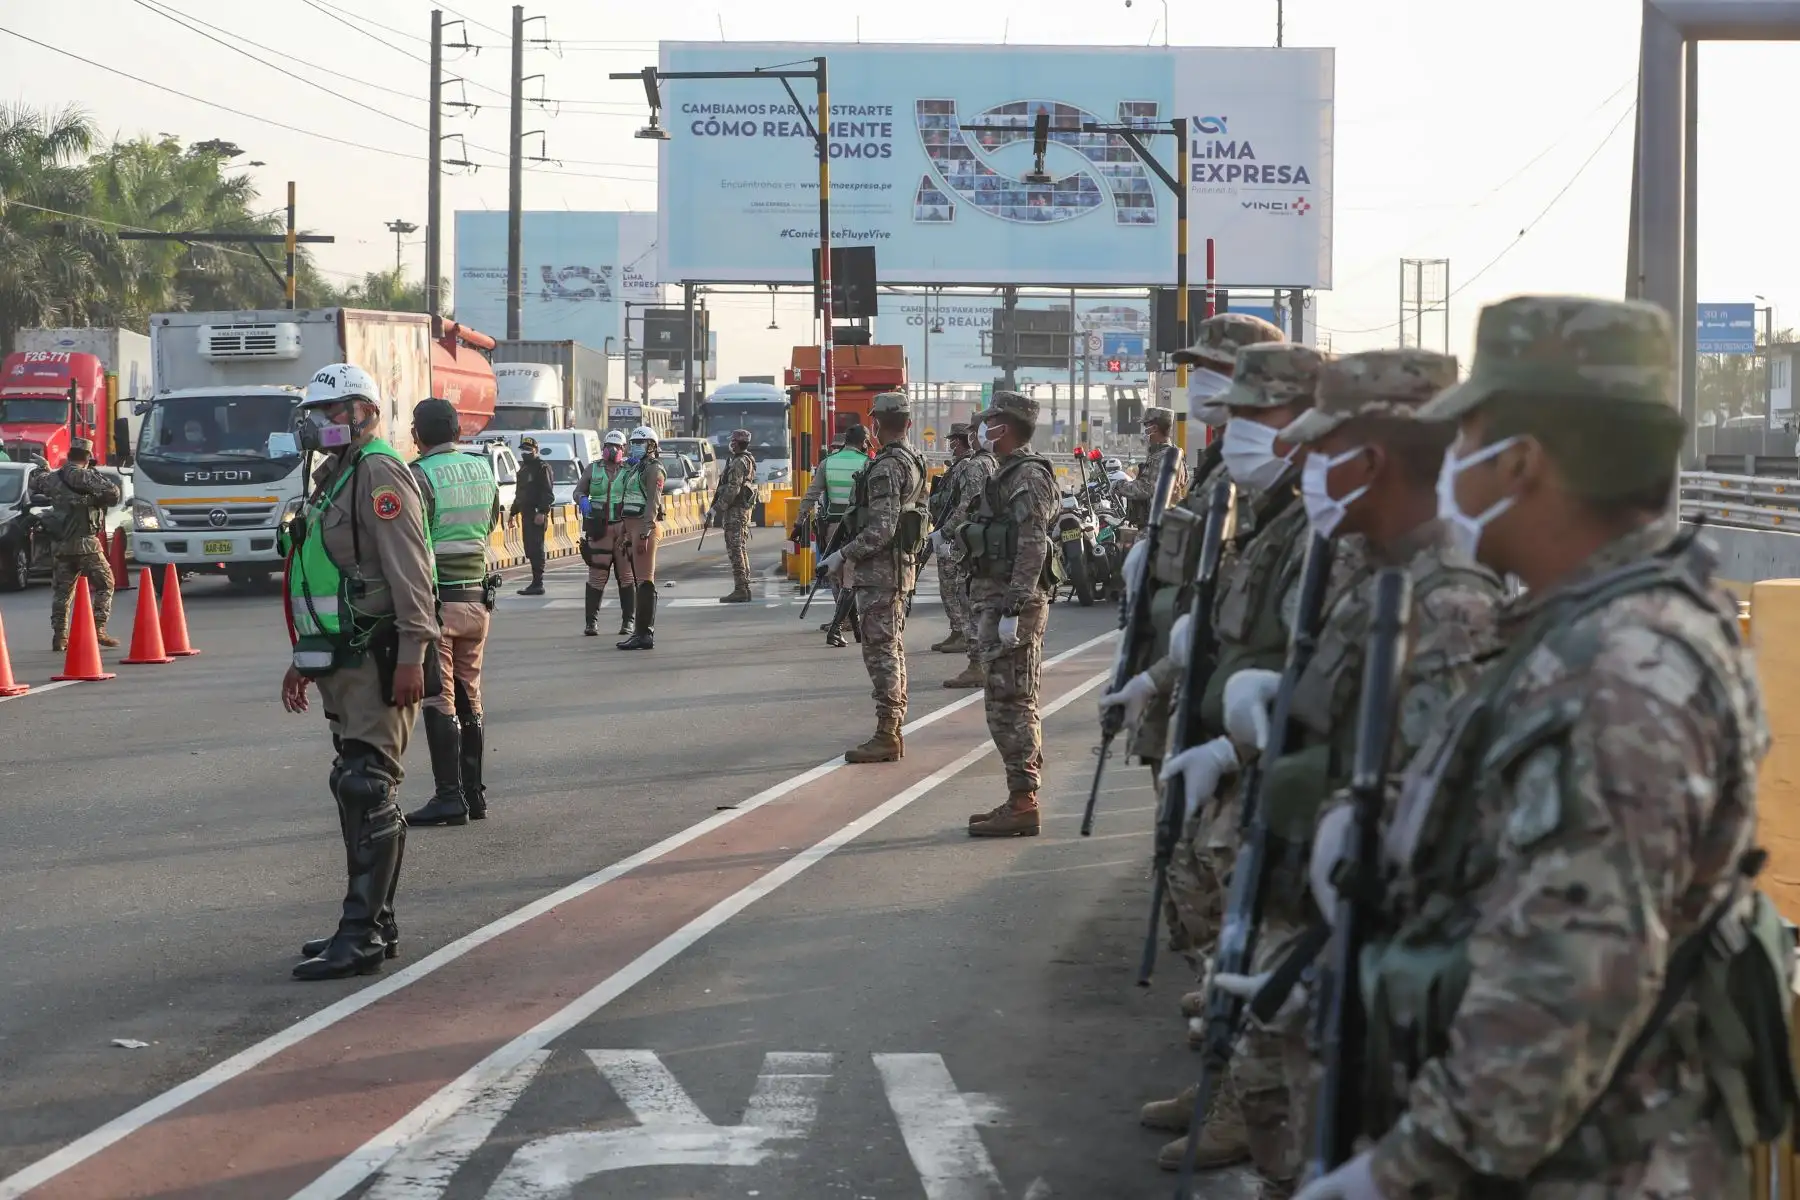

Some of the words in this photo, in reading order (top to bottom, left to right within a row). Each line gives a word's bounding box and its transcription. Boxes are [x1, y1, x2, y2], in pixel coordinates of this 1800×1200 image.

[681, 103, 766, 115] CAMBIAMOS
[808, 105, 893, 116] MSTRARTE
[691, 115, 757, 137] CÓMO
[1191, 163, 1311, 185] EXPRESA
[1241, 201, 1288, 210] VINCI
[24, 351, 71, 363] F2G-771
[615, 408, 633, 416] ATE
[184, 470, 251, 482] FOTON
[435, 462, 489, 488] POLICIA
